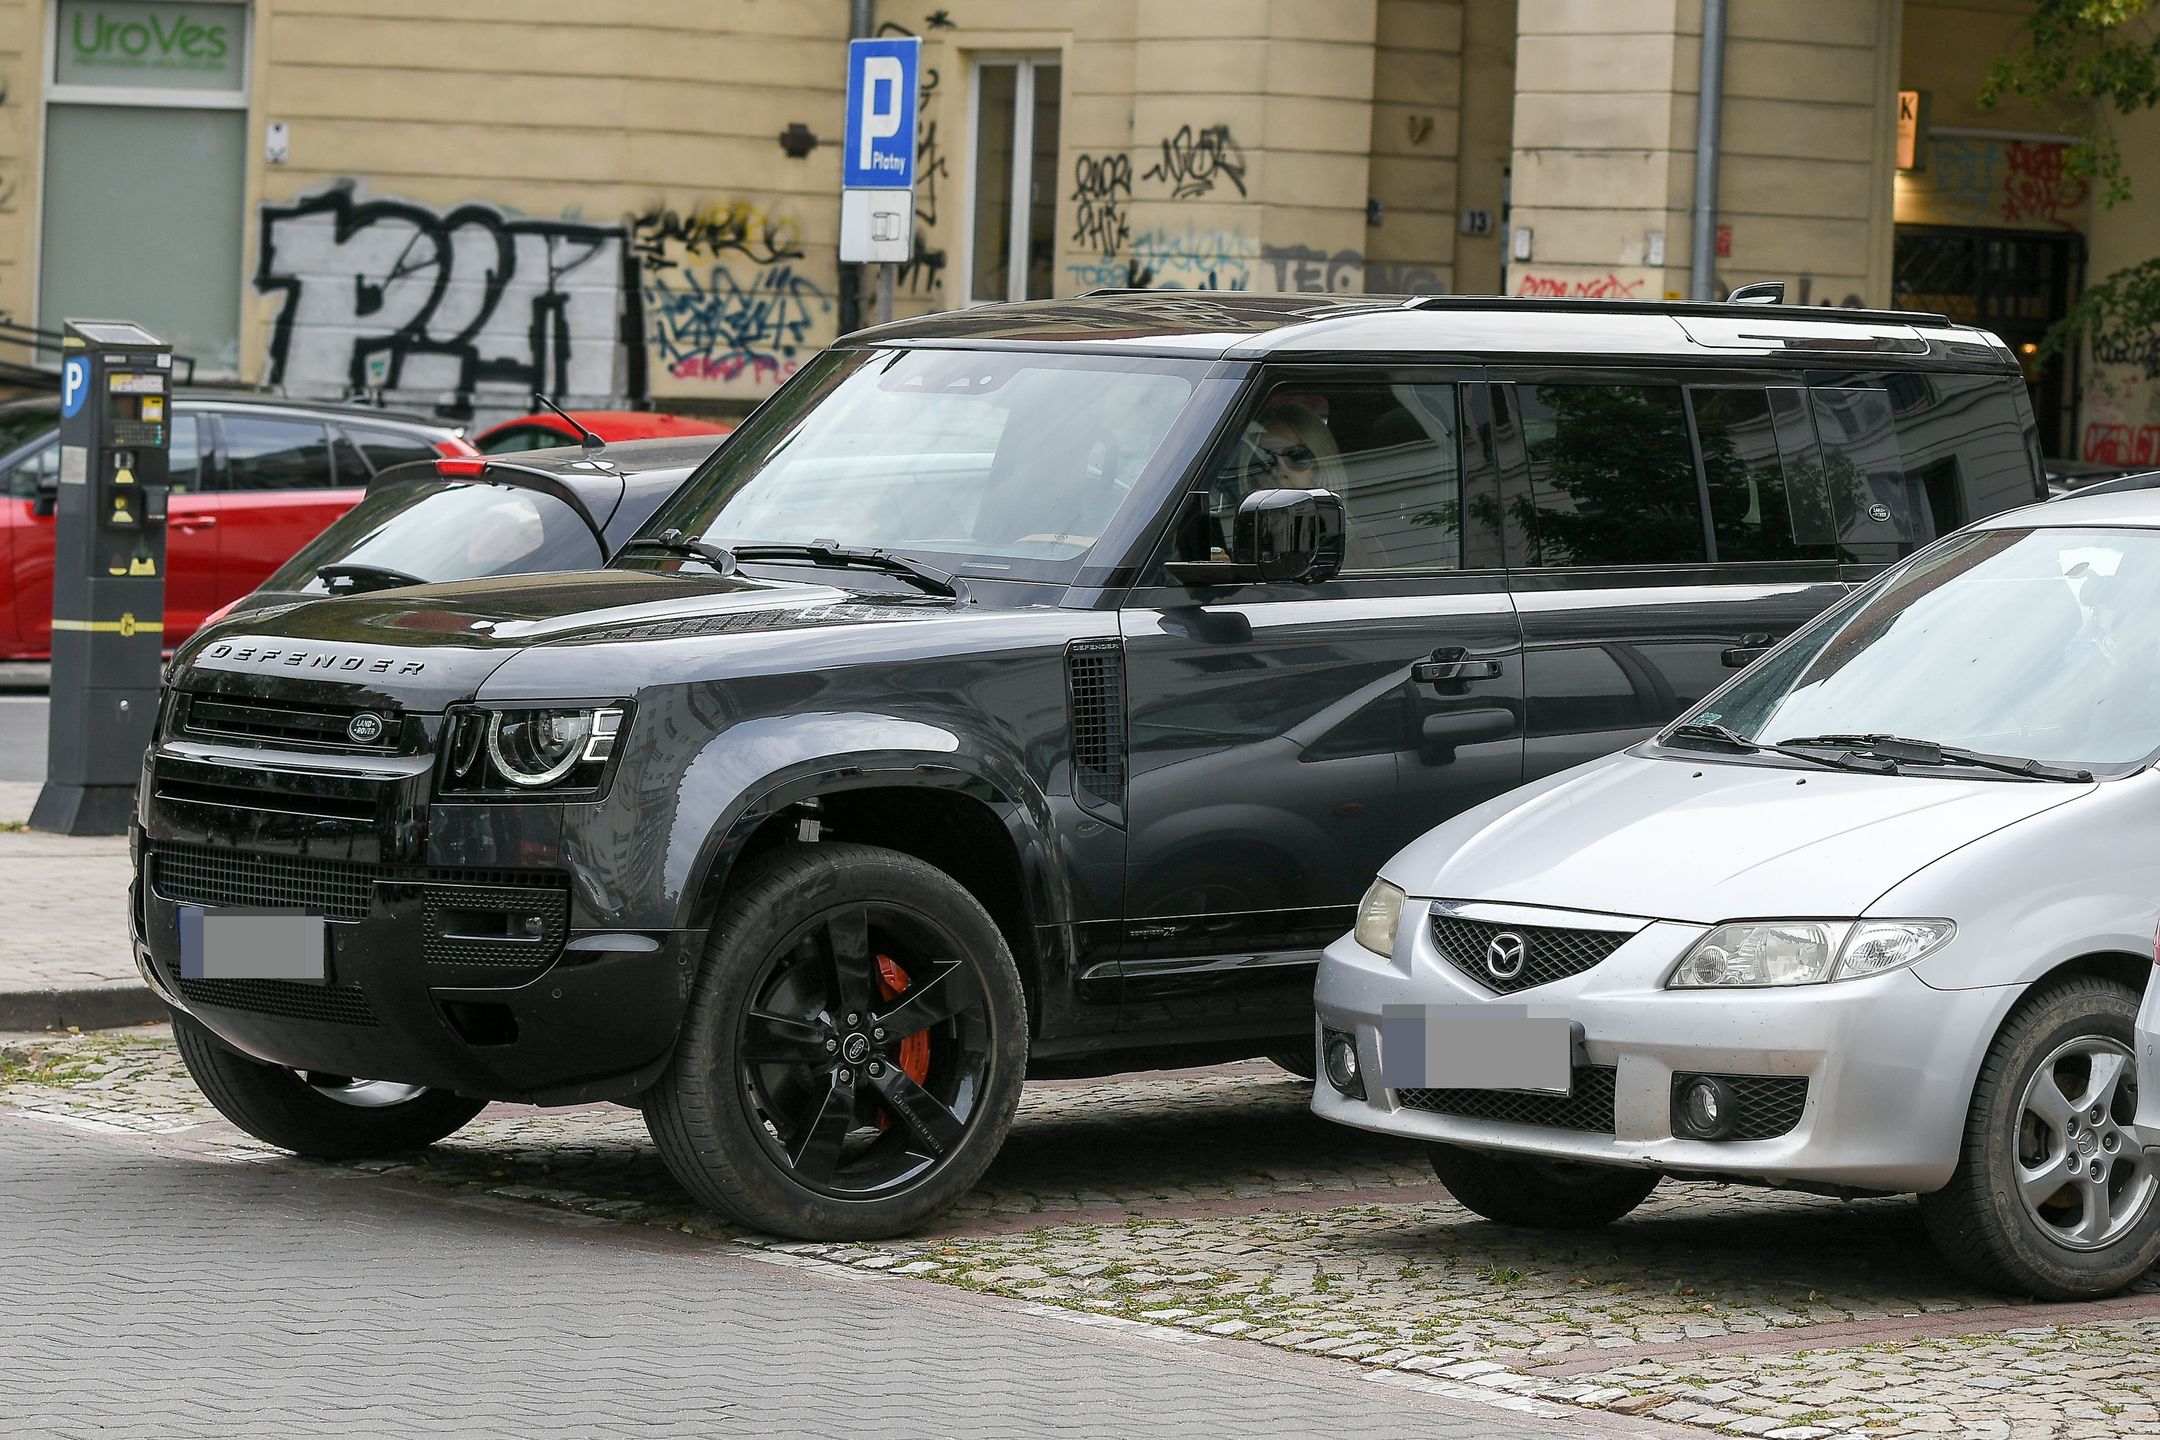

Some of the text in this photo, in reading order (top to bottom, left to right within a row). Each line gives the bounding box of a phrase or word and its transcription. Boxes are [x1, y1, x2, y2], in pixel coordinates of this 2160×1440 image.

[73, 11, 227, 57] UroVes
[859, 56, 904, 171] P
[1470, 210, 1488, 232] 13
[64, 361, 83, 407] P
[210, 644, 425, 675] DEFENDER
[1073, 642, 1119, 651] DEFENDER
[356, 719, 373, 728] LAND
[356, 726, 376, 735] ROVER
